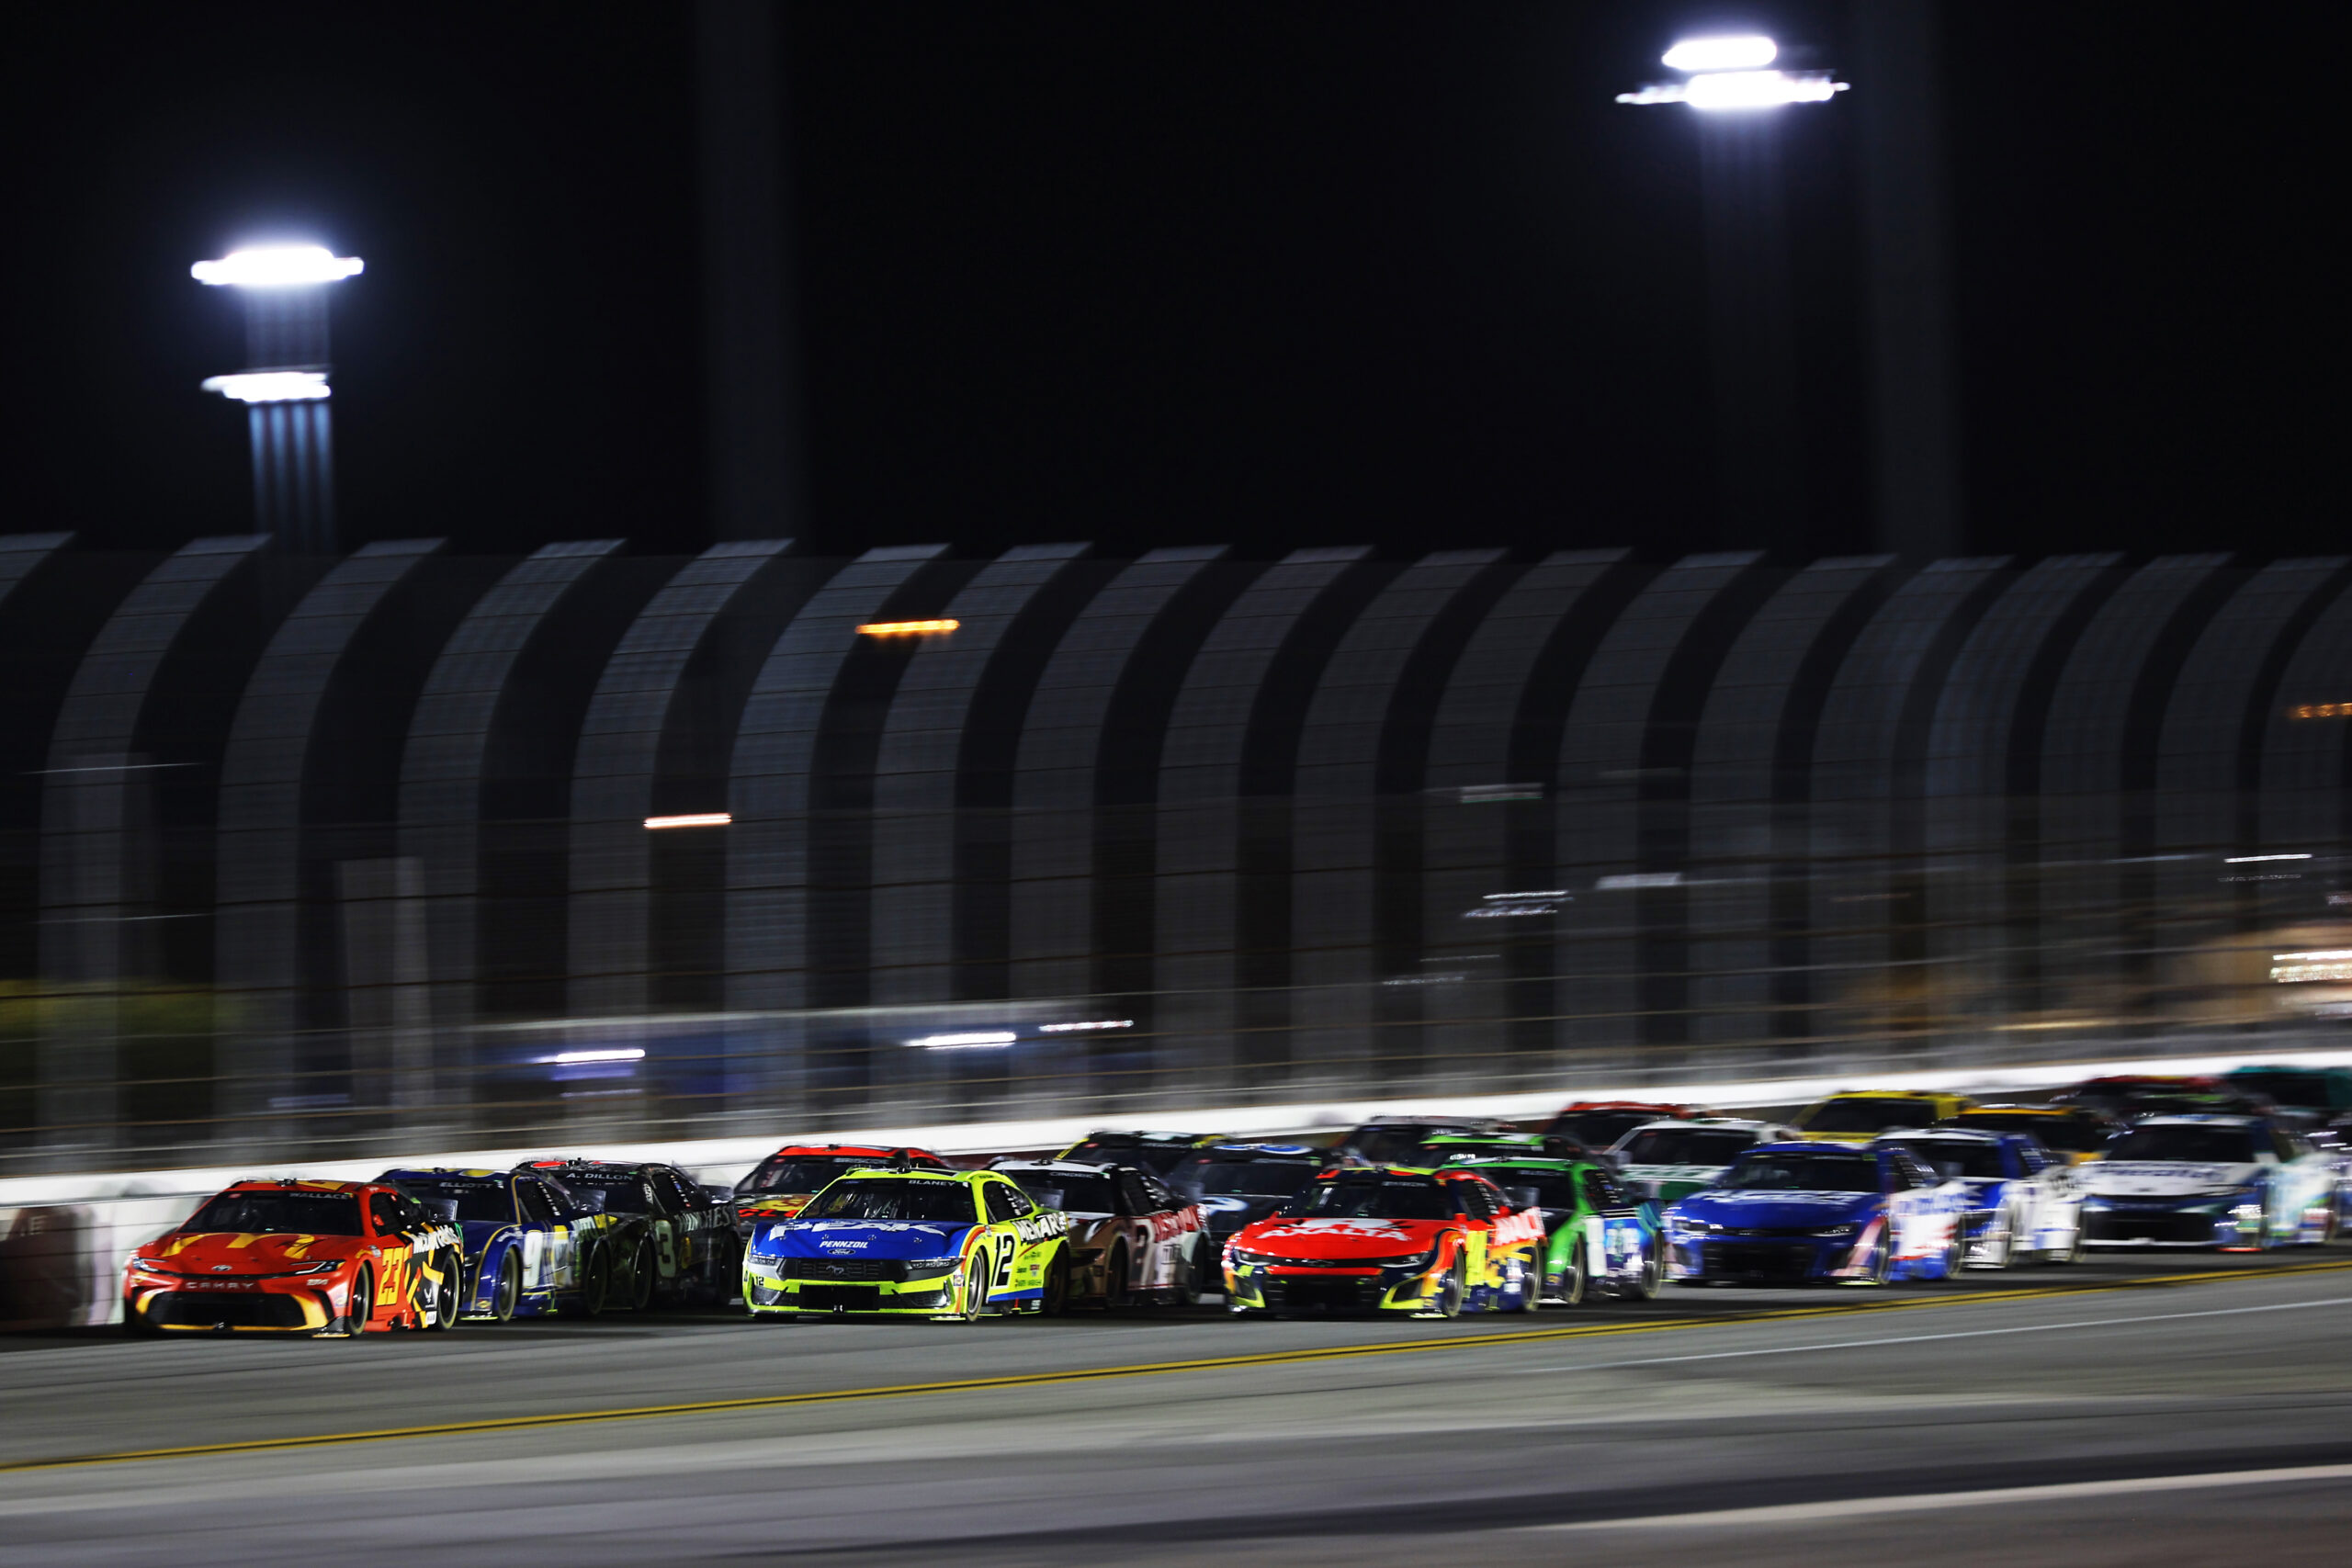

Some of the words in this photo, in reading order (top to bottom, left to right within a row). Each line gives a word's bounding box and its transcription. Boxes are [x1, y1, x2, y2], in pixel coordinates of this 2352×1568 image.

[585, 1172, 634, 1180] DILLON
[769, 1219, 947, 1241] PEAK
[1257, 1227, 1412, 1241] AXALTA
[655, 1219, 676, 1278] 3
[990, 1235, 1015, 1287] 12
[376, 1247, 404, 1306] 23
[754, 1276, 764, 1286] 12
